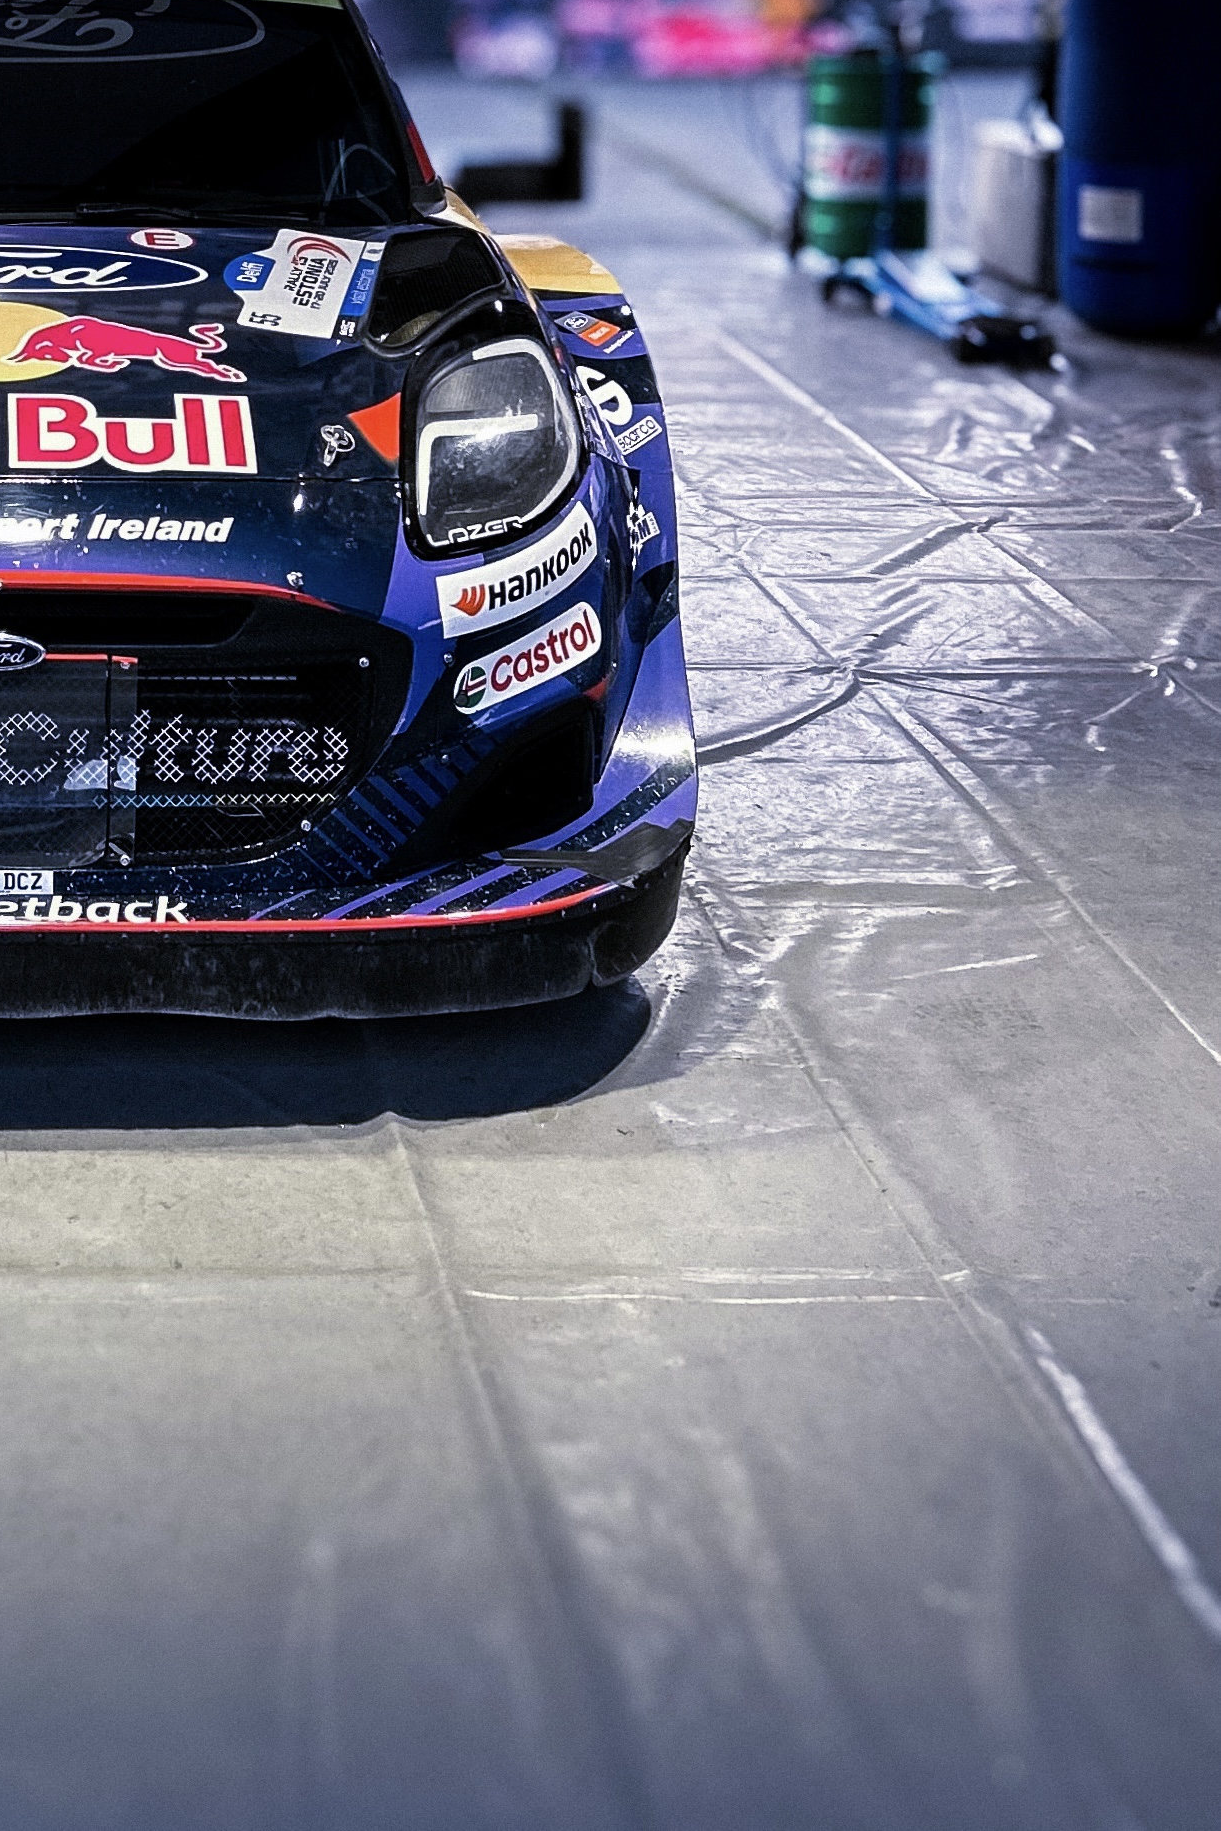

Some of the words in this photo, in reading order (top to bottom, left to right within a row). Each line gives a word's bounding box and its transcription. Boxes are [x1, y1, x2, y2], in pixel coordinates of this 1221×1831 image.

[143, 230, 175, 247] E
[283, 265, 303, 292] RALLY
[292, 257, 328, 307] ESTONIA
[14, 397, 248, 467] Bull
[87, 513, 235, 544] Ireland
[426, 515, 523, 547] LAZER
[490, 609, 597, 693] Castrol
[3, 871, 44, 891] DCZ
